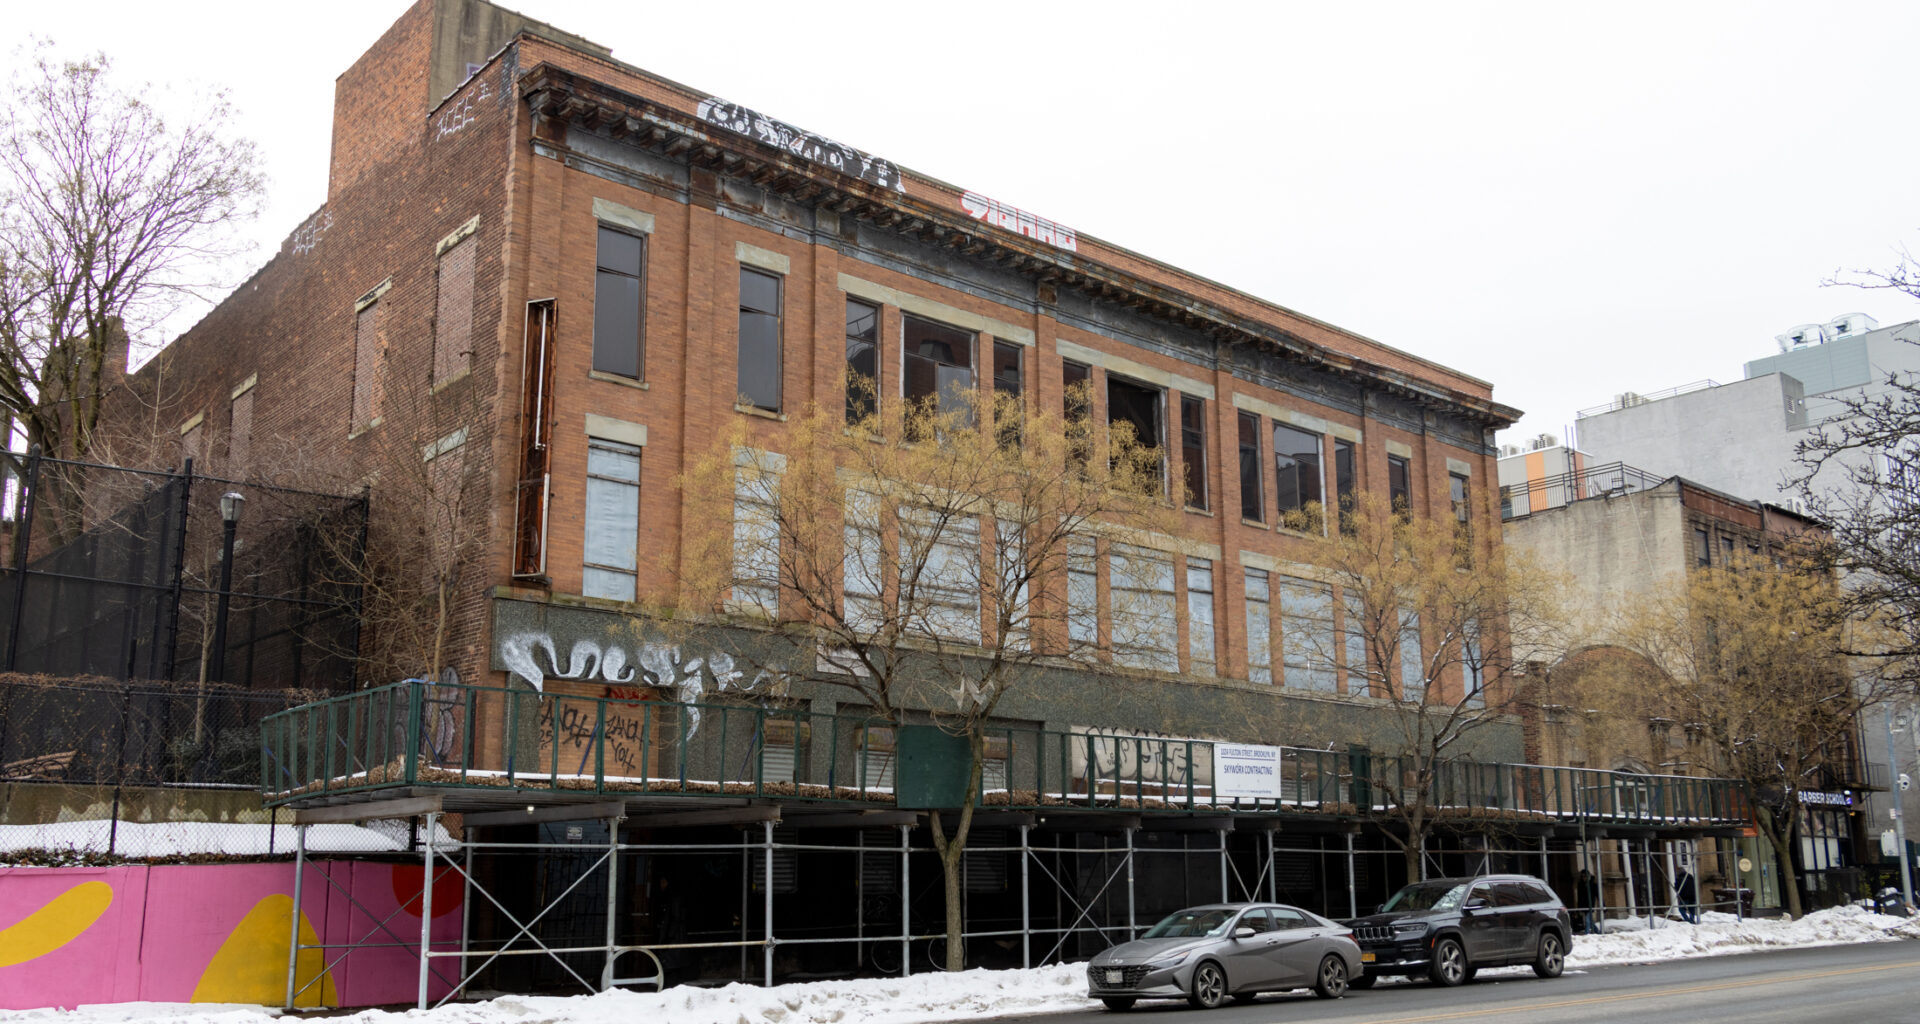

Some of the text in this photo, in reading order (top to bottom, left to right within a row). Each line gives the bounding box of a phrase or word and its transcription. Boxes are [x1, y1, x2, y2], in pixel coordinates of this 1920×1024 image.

[1245, 766, 1272, 775] CONTRACTING
[1798, 791, 1847, 805] BARBER SCHOOL
